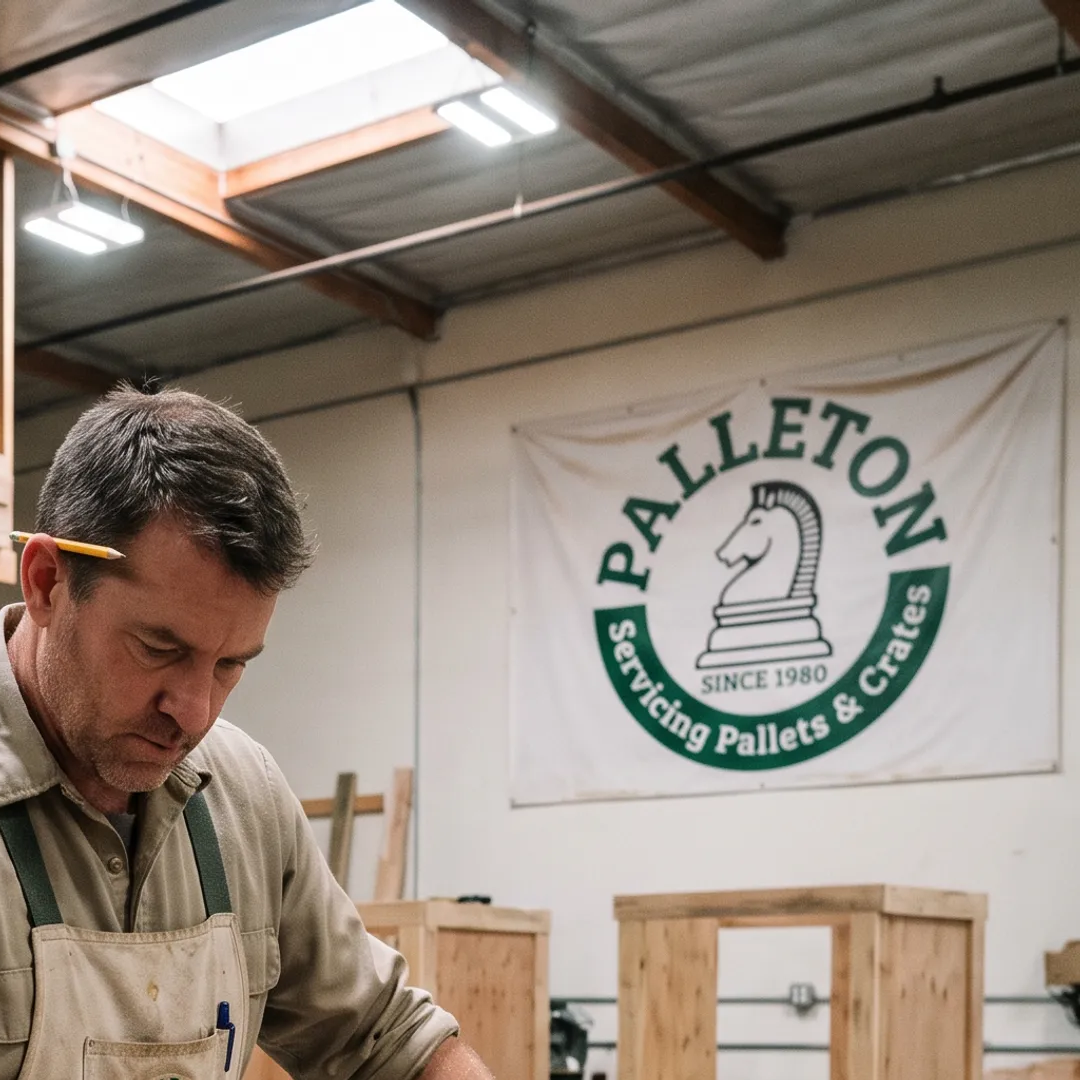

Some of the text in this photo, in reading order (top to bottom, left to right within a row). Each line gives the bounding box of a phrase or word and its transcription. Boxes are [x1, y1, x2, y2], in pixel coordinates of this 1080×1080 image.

[597, 398, 947, 591] PALLETON
[608, 584, 932, 756] Servicing Pallets & Crates
[701, 664, 828, 695] SINCE 1980
